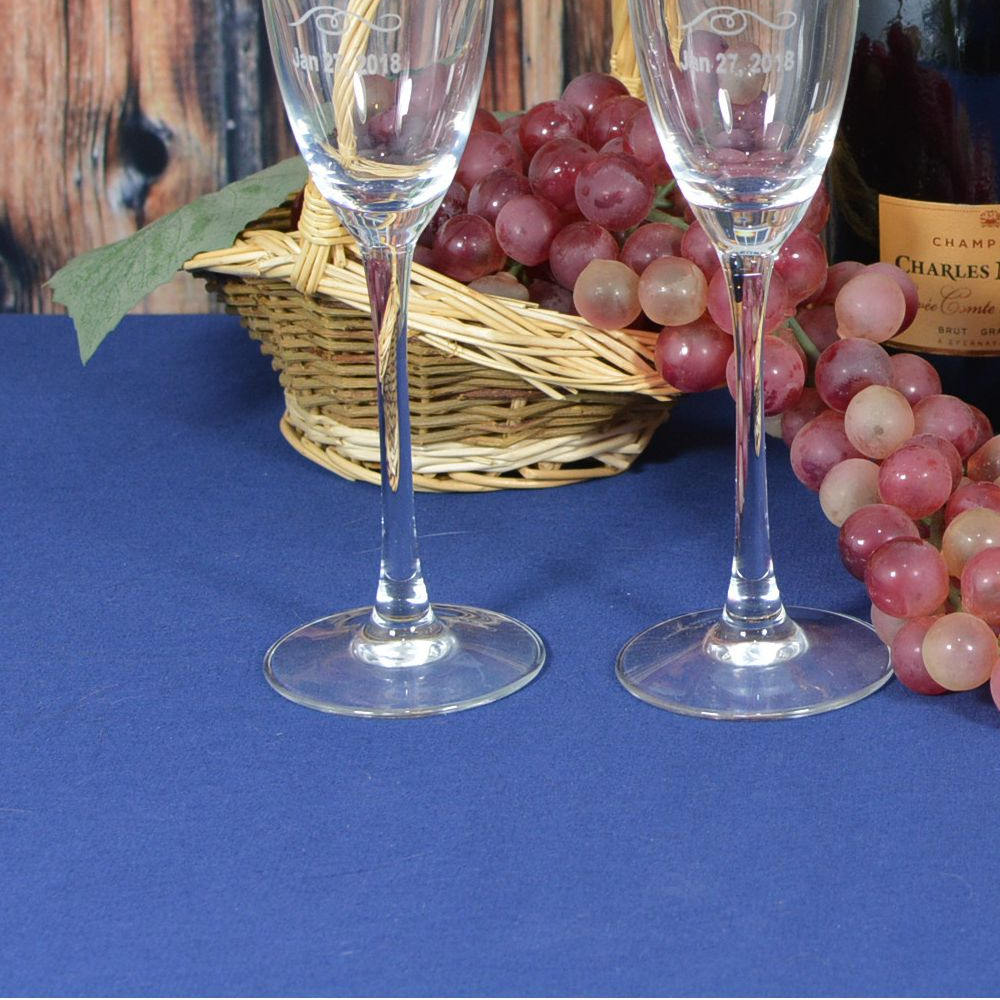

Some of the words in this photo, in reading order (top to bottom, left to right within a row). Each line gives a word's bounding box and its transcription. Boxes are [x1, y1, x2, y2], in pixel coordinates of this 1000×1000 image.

[293, 47, 319, 72] Jan
[680, 49, 712, 73] Jan
[750, 50, 795, 74] 2018
[895, 254, 990, 281] CHARLES
[938, 326, 968, 336] BRUT
